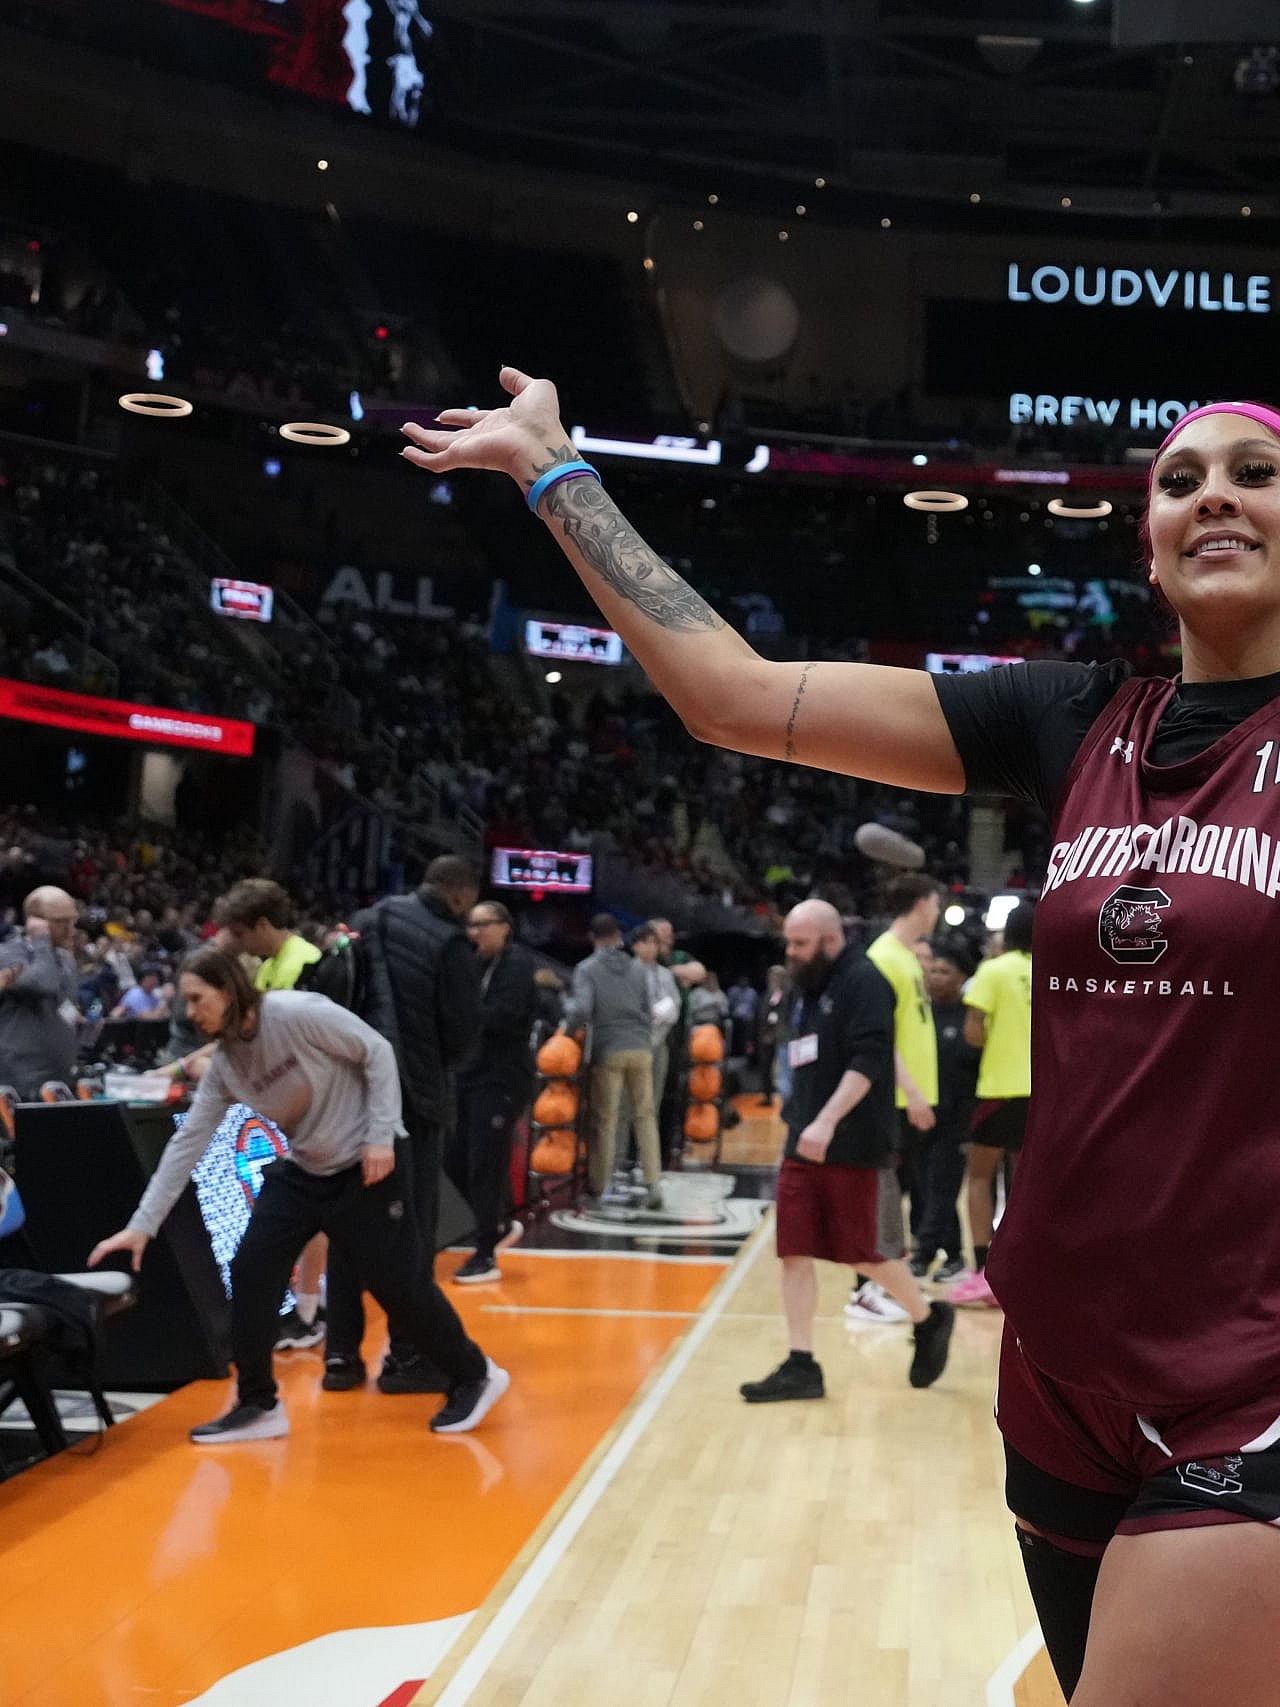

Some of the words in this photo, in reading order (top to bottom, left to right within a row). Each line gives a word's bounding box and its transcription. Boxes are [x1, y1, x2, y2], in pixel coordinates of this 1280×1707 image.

[1008, 262, 1271, 313] LOUDVILLE
[1009, 393, 1120, 426] BREW
[321, 565, 455, 620] ALL
[1040, 825, 1132, 901] SOUTH
[1049, 976, 1234, 996] BASKETBALL
